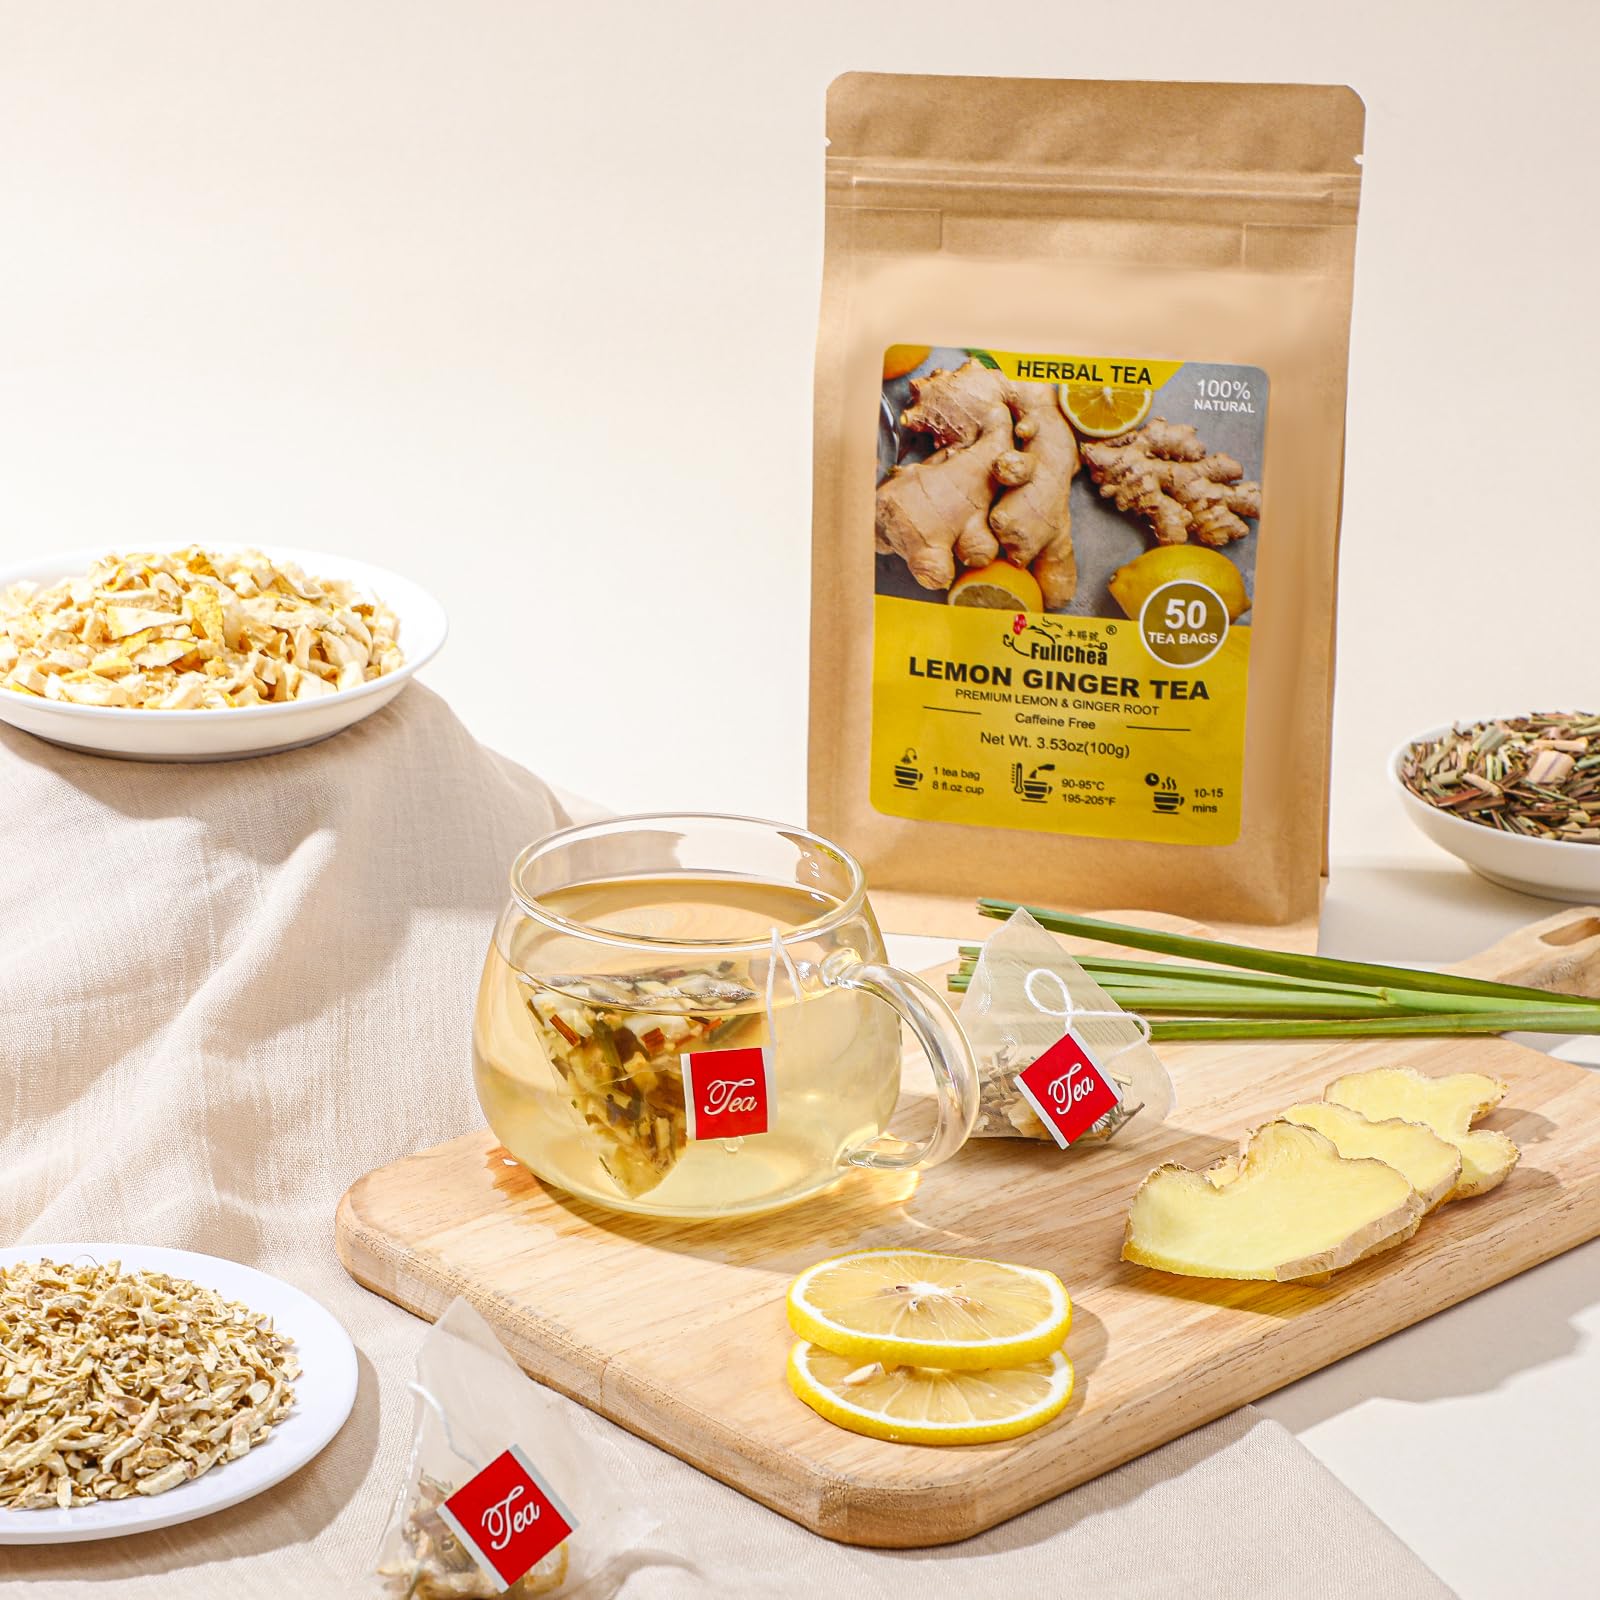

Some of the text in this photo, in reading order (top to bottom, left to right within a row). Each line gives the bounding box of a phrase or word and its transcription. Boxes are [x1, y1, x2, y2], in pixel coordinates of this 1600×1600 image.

[1017, 360, 1152, 385] HERBAL TEA
[1197, 379, 1251, 400] 100%
[1193, 399, 1255, 414] NATURAL
[1164, 598, 1207, 630] 50
[1148, 631, 1218, 645] TEA BAGS
[1031, 642, 1108, 666] FullChea
[909, 656, 1210, 700] LEMON GINGER TEA
[955, 688, 1160, 716] PREMIUM LEMON & GINGER ROOT
[1015, 713, 1096, 730] Caffeine Free
[980, 732, 1130, 759] Net Wt. 3.53oz(100g)
[933, 766, 981, 781] 1 tea bag
[932, 781, 939, 789] 8
[965, 786, 985, 796] cup
[1061, 778, 1105, 791] 90-95°C
[1194, 788, 1224, 798] 10-15
[1062, 793, 1116, 806] 195-205°F
[1192, 803, 1218, 813] mins
[703, 1078, 758, 1116] Tea
[1047, 1062, 1095, 1116] Tea
[481, 1485, 541, 1551] Tea
